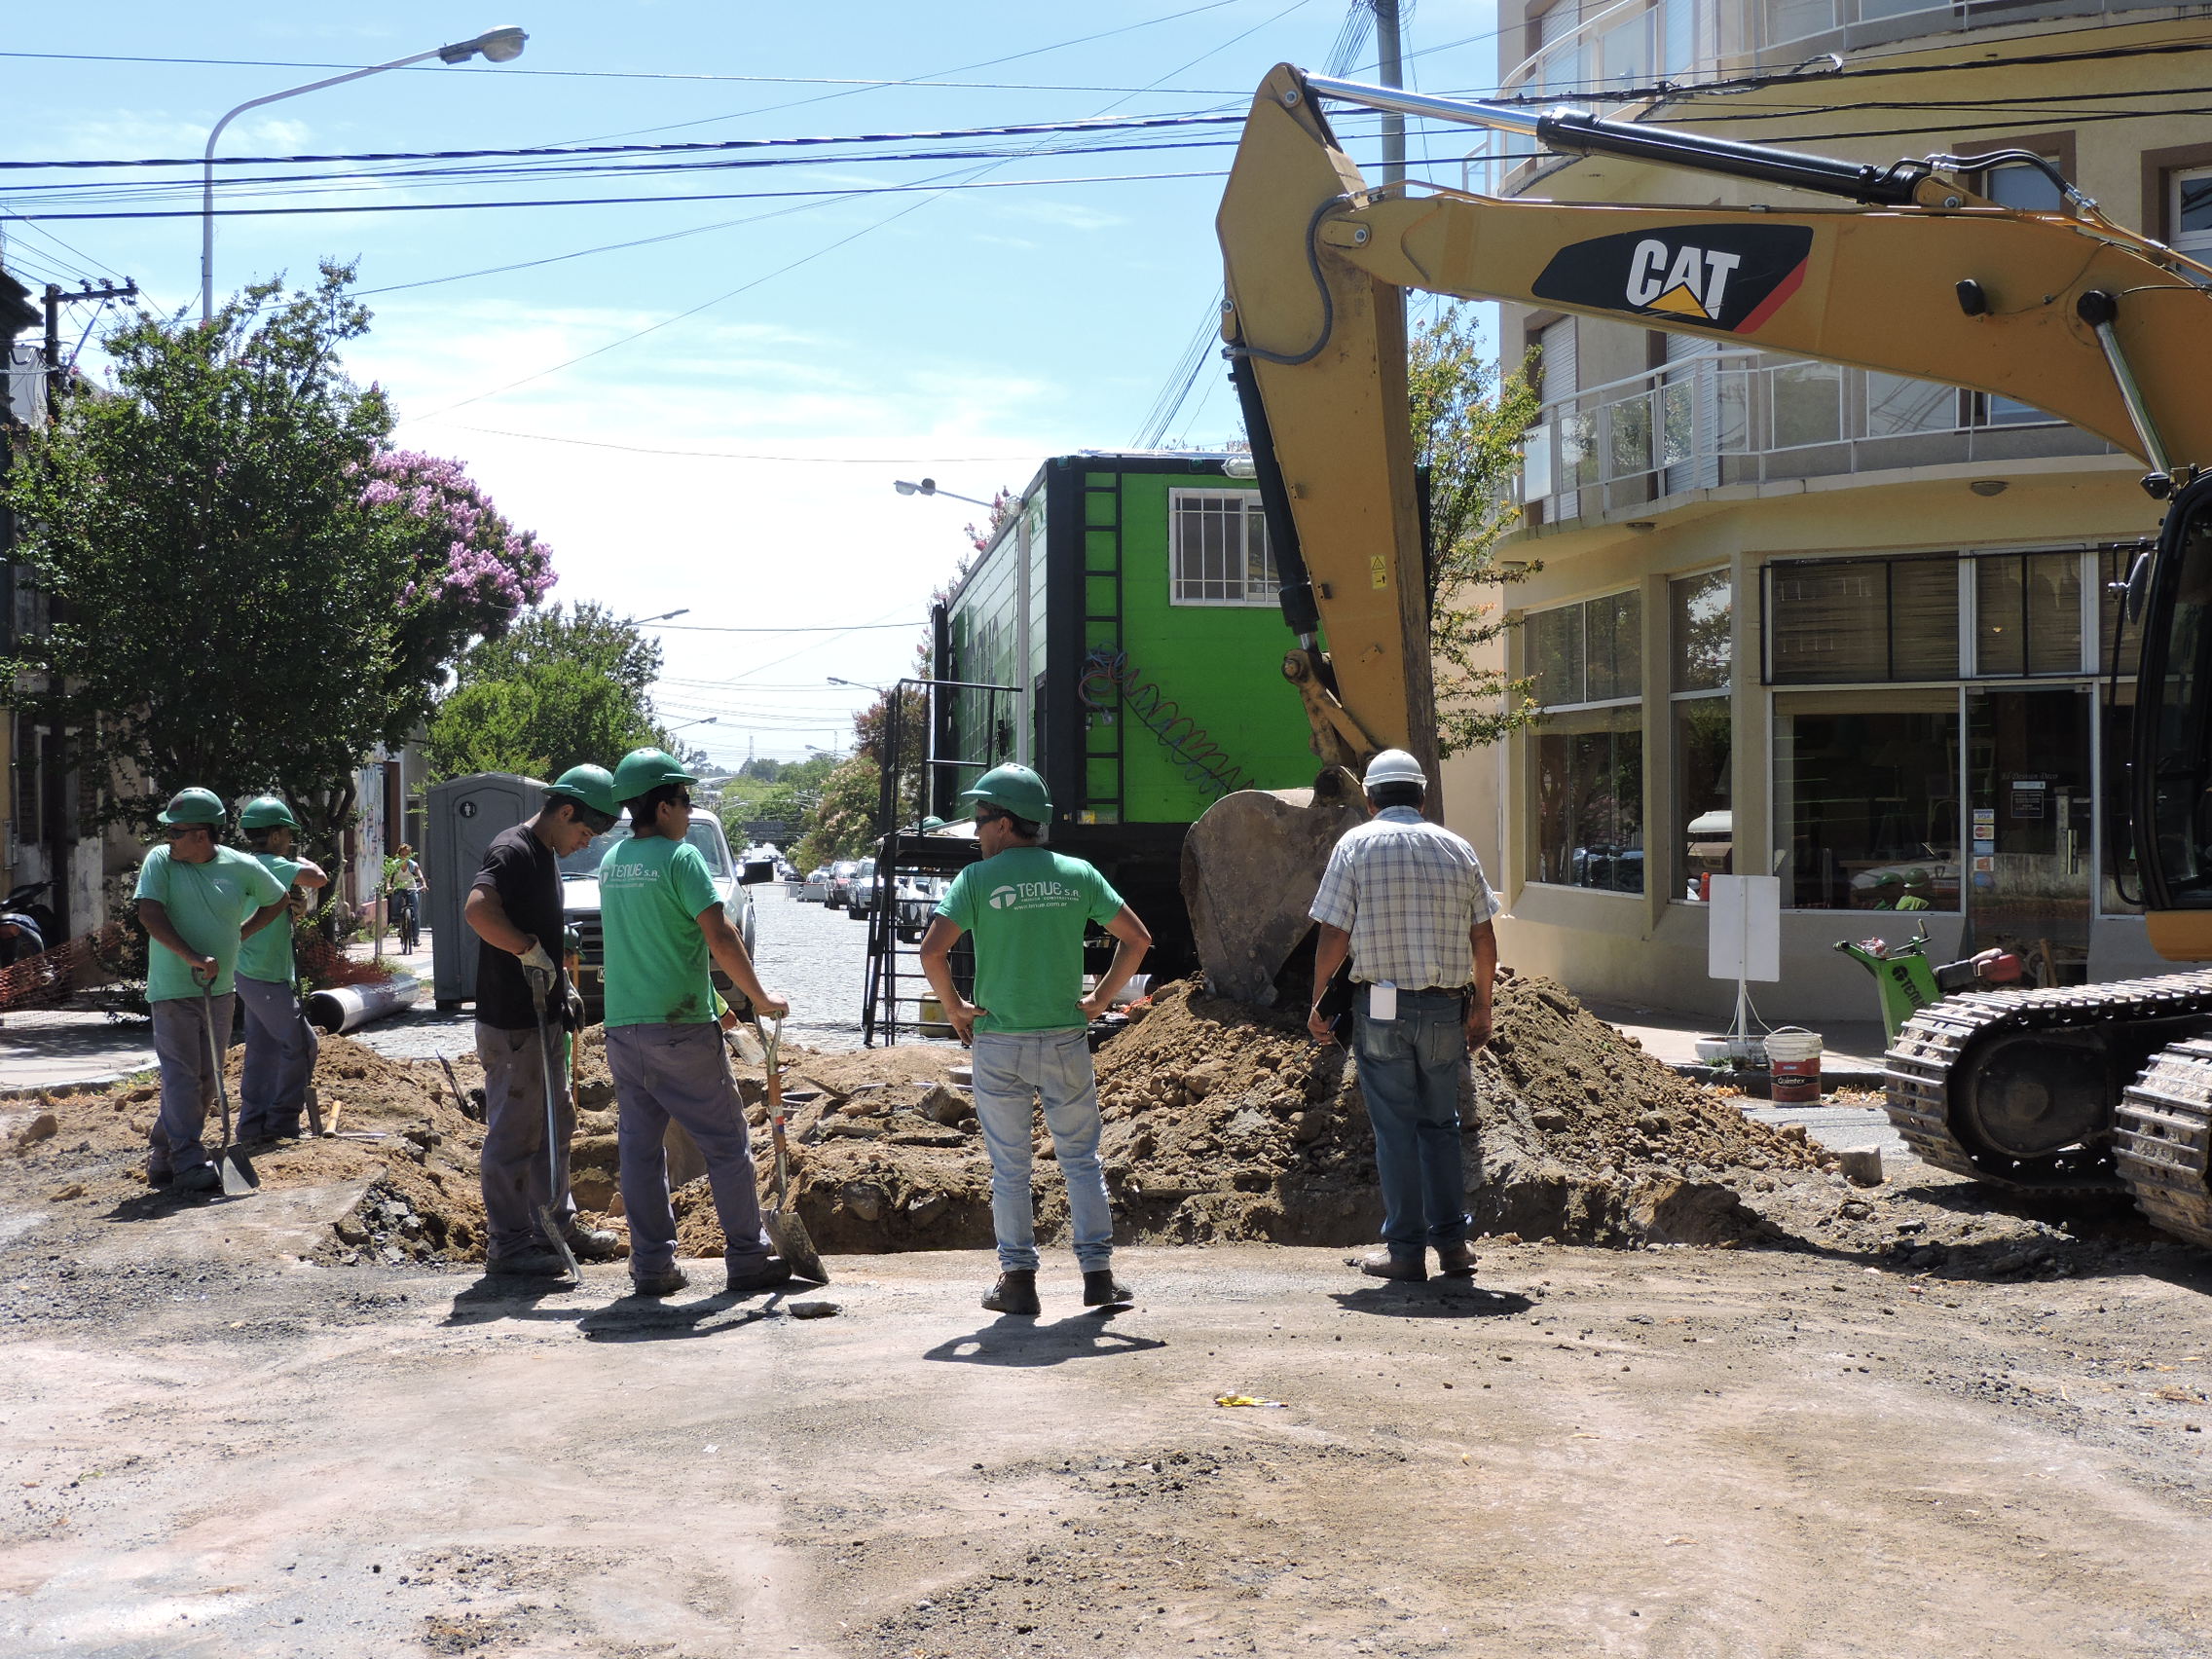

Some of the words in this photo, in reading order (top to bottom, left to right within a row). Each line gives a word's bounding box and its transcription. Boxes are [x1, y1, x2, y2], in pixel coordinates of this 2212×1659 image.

[1626, 239, 1741, 320] CAT
[610, 863, 644, 877] TENUE
[1016, 881, 1062, 898] TENUE
